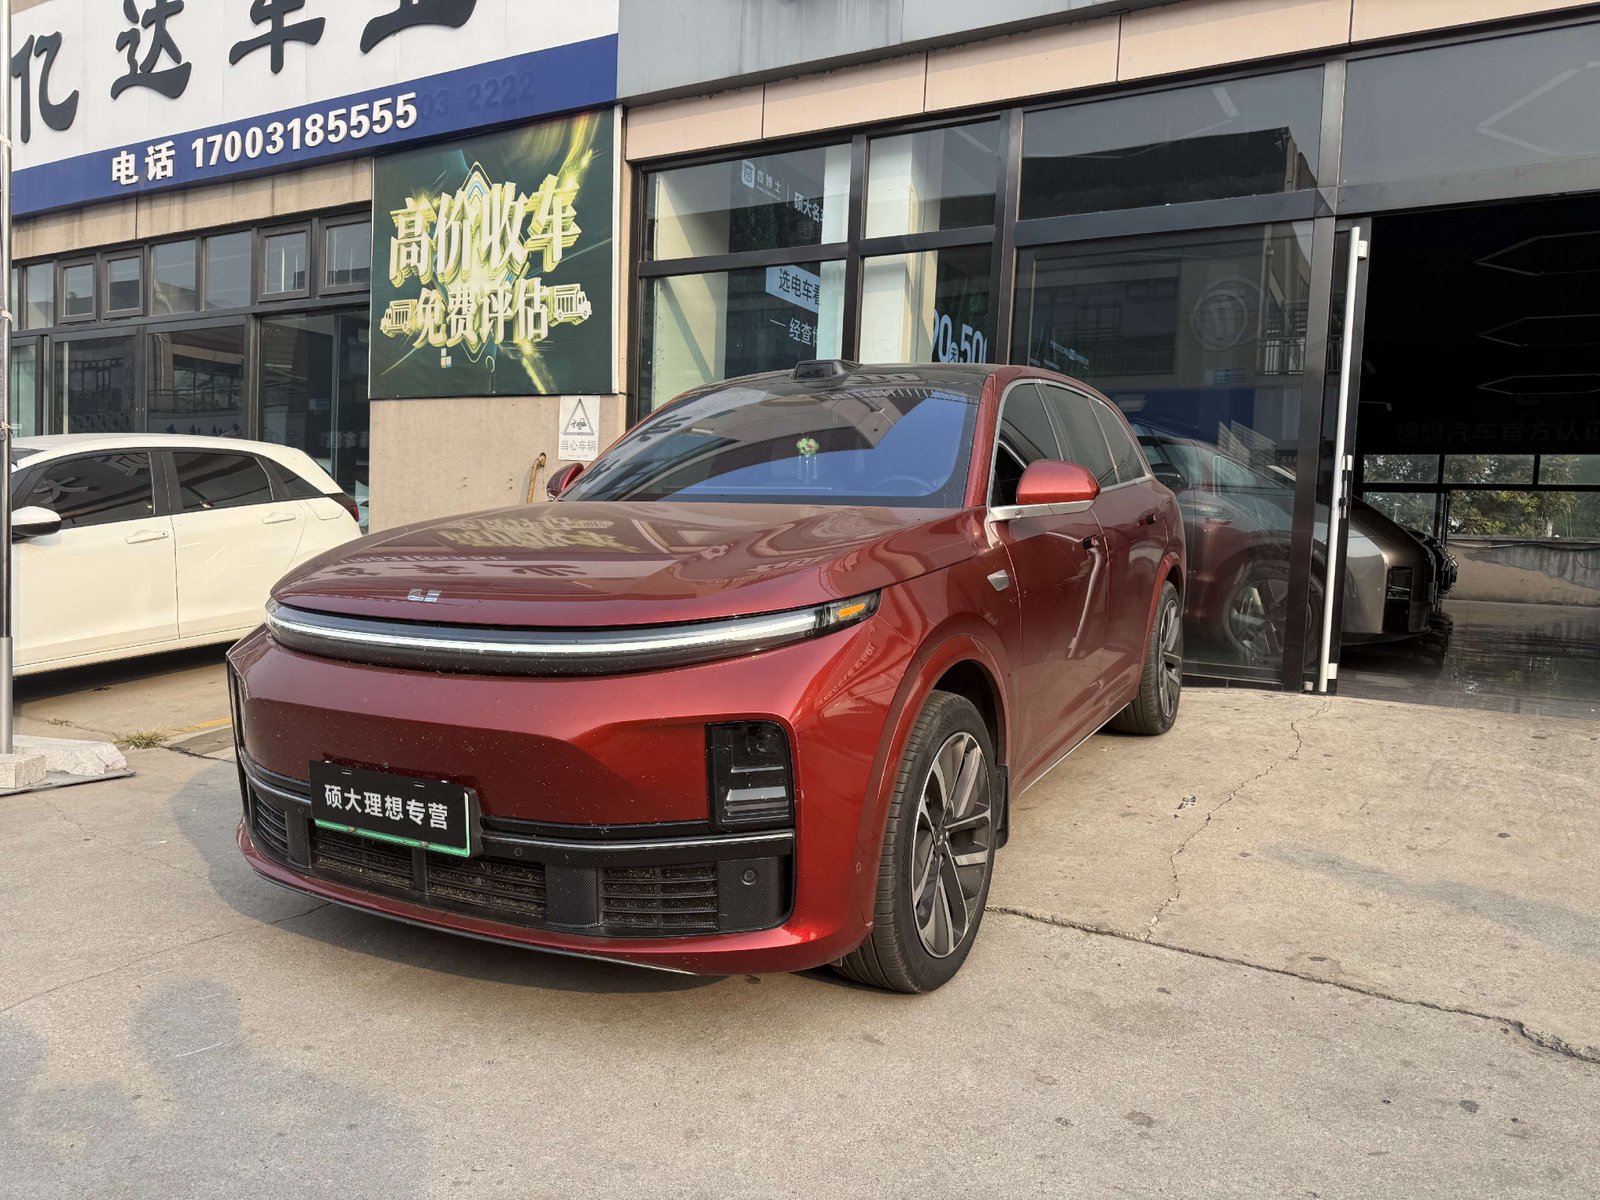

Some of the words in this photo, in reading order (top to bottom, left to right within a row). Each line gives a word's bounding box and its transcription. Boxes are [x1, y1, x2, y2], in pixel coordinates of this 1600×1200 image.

[111, 140, 176, 186] 电话
[191, 92, 418, 168] 17003185555
[389, 174, 581, 285] 高价收车
[413, 277, 549, 347] 免费评估
[560, 440, 597, 451] 当心车辆
[324, 784, 448, 830] 硕大理想专营
